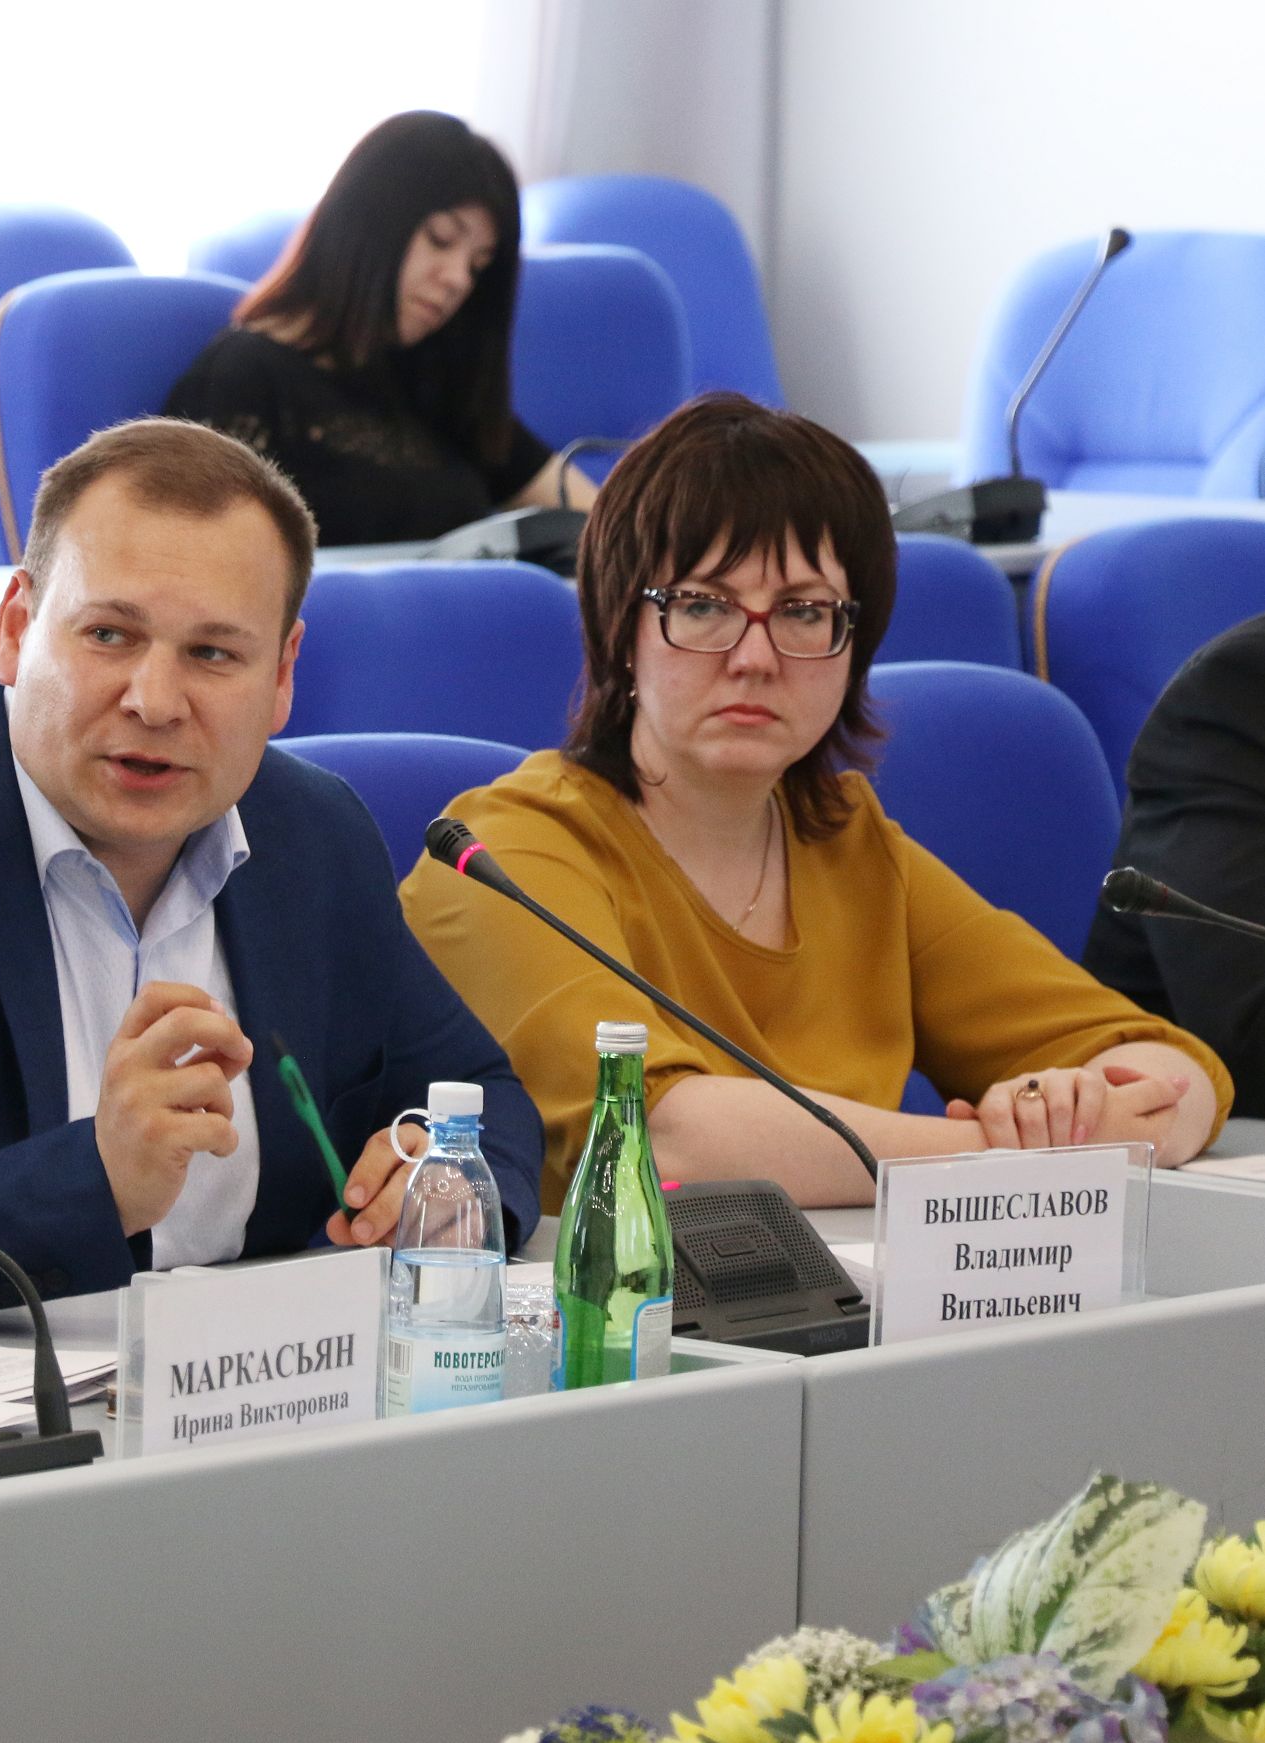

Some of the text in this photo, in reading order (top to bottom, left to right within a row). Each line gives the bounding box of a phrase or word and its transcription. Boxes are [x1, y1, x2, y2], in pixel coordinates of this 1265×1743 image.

[924, 1188, 1109, 1225] ВЫШЕСЛАВОВ
[954, 1242, 1073, 1273] Владимир
[939, 1292, 1082, 1322] Витальевич
[168, 1333, 356, 1399] МАРКАСЬЯН
[172, 1412, 234, 1444] Ирина
[239, 1390, 350, 1428] Викторовна
